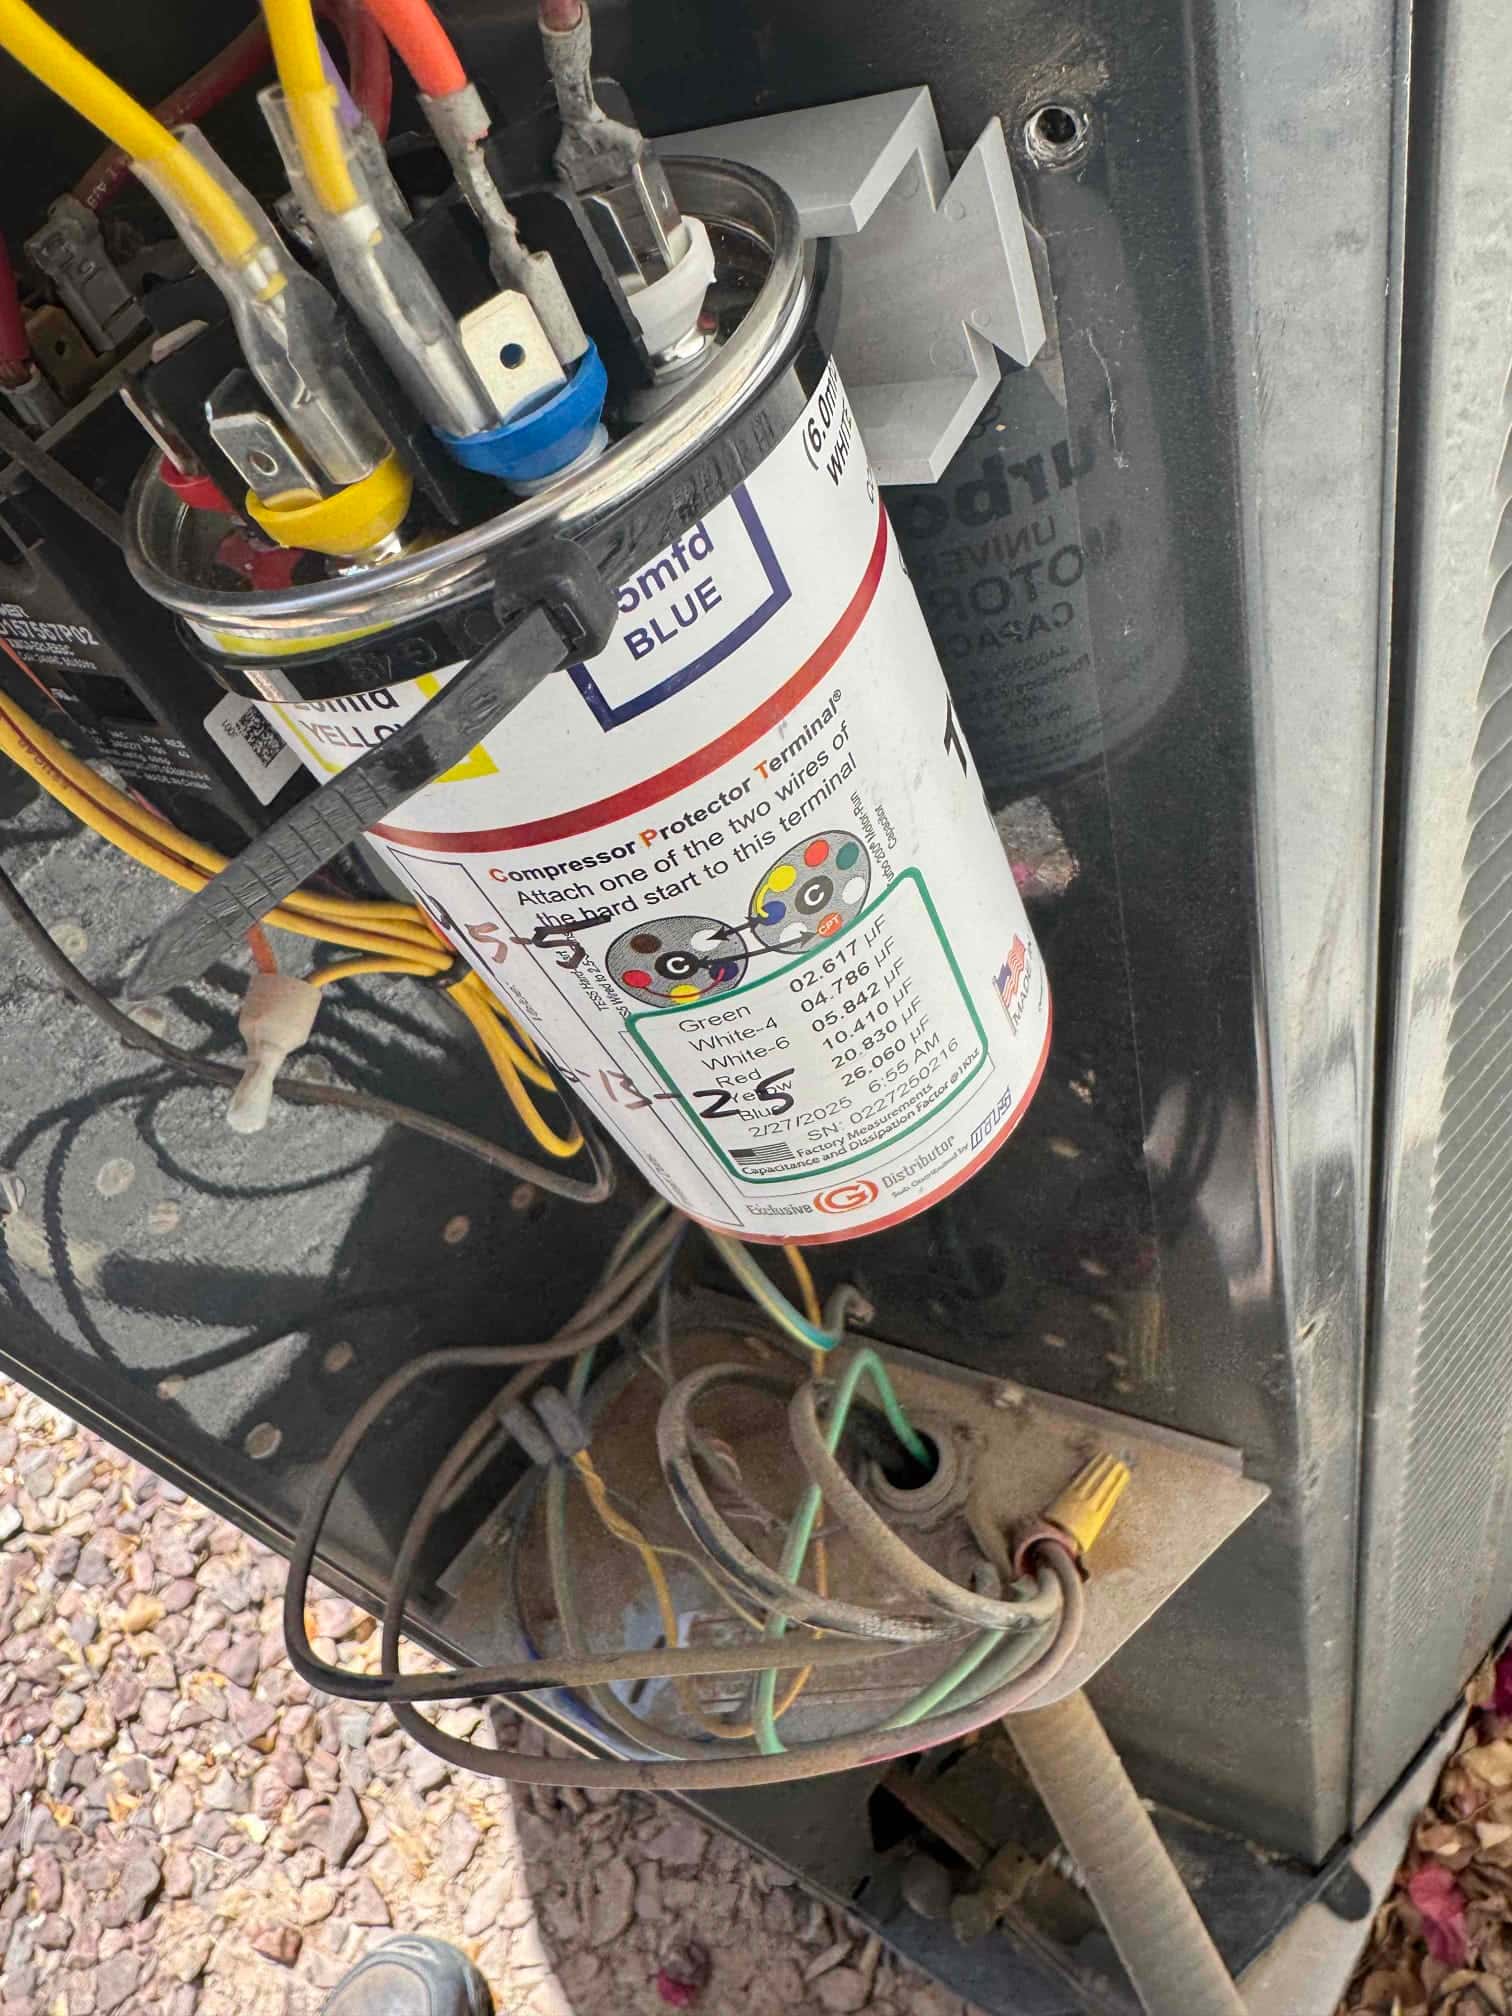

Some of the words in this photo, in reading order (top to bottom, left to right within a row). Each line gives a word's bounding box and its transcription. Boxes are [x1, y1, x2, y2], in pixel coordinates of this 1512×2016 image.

[623, 576, 722, 661] BLUE
[299, 720, 404, 748] YELLO
[488, 840, 636, 883] Compressor
[639, 777, 751, 848] Protector
[517, 883, 594, 906] Attach
[600, 867, 648, 892] one
[654, 849, 681, 873] of
[683, 829, 725, 860] the
[728, 801, 771, 834] two
[775, 750, 830, 801] wires
[832, 720, 849, 750] of
[536, 911, 577, 930] the
[579, 895, 639, 922] hard
[644, 872, 702, 905] start
[703, 860, 729, 880] to
[733, 830, 776, 863] this
[779, 752, 857, 833] terminal
[804, 884, 825, 906] C
[817, 914, 841, 936] CPT
[666, 956, 690, 974] C
[789, 938, 858, 994] 02.617
[864, 913, 887, 948] µF
[800, 961, 870, 1013] 04.786
[873, 935, 896, 968] µF
[679, 1005, 751, 1032] Green
[811, 981, 881, 1033] 05.842
[883, 956, 905, 989] µF
[822, 1000, 889, 1050] 10.410
[892, 976, 914, 1007] µF
[688, 1016, 778, 1052] White-4
[701, 1036, 790, 1071] White-6
[831, 1019, 898, 1070] 20.830
[901, 995, 923, 1025] µF
[840, 1037, 907, 1088] 26.060
[909, 1014, 931, 1044] µF
[715, 1068, 762, 1088] Red
[731, 1080, 792, 1104] Yeow
[747, 1096, 852, 1138] 2/27/2025
[868, 1060, 910, 1094] 6:55
[913, 1031, 941, 1065] AM
[850, 1038, 959, 1124] 0227250216
[742, 1157, 821, 1176] Capacitance
[822, 1148, 847, 1161] and
[849, 1111, 915, 1151] Dissipation
[915, 1080, 949, 1113] Factor
[795, 1136, 845, 1158] Factory
[847, 1082, 933, 1141] Measurements
[746, 1203, 814, 1216] Exclusive
[882, 1135, 955, 1189] Distributor
